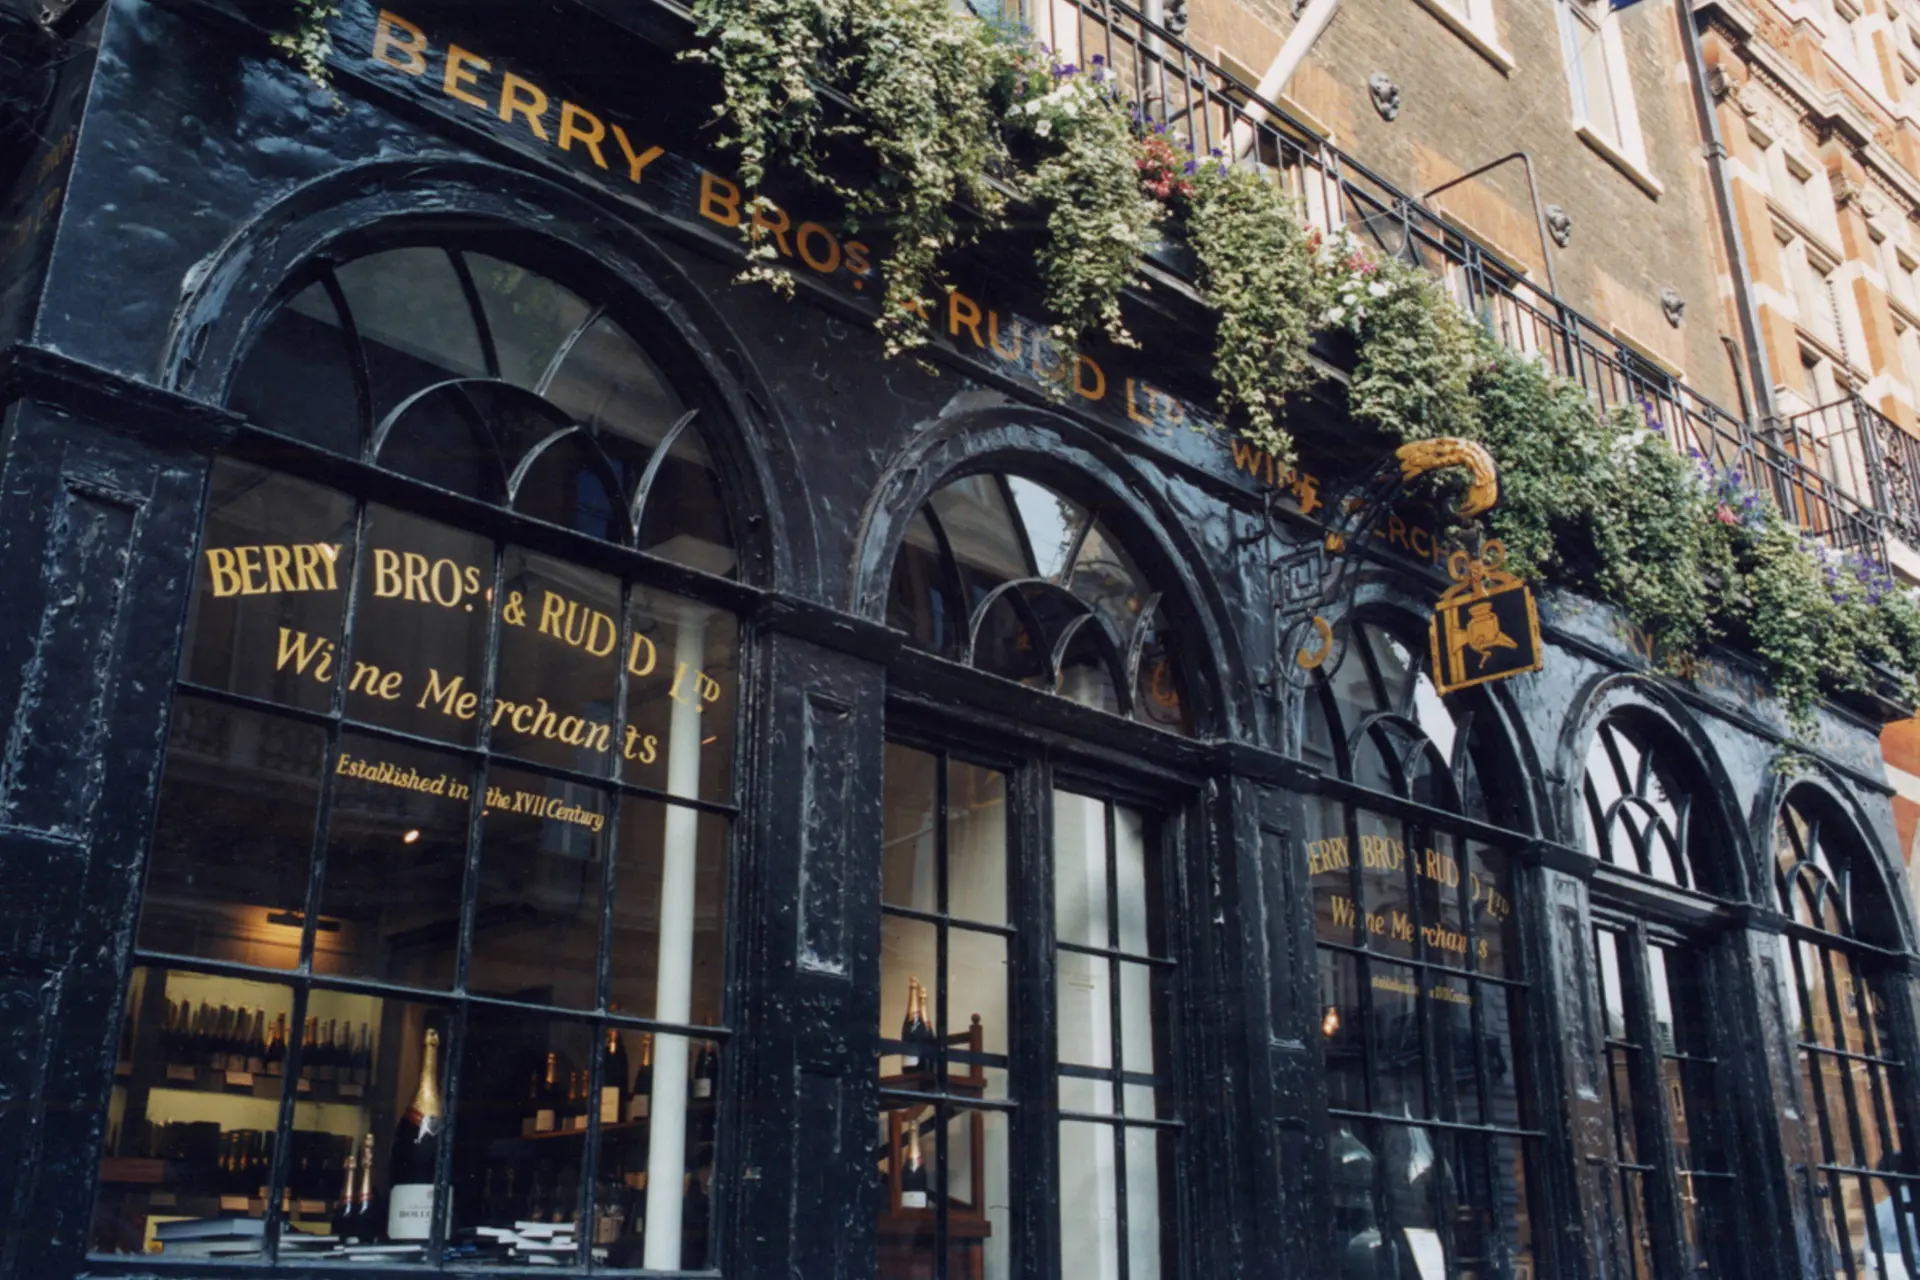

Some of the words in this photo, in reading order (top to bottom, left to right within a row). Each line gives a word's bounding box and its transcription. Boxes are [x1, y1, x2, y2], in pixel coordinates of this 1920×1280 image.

[371, 8, 665, 185] BERRY
[949, 289, 1106, 400] RUDD
[205, 543, 342, 598] BERRY
[502, 589, 527, 628] &
[537, 589, 657, 678] RUDD
[276, 626, 404, 701] Wine
[416, 667, 659, 765] Merchants
[335, 753, 445, 796] Established
[448, 778, 470, 800] in
[486, 786, 512, 811] the
[512, 789, 546, 817] XVII
[546, 798, 605, 832] Century
[1330, 893, 1385, 935] Wine
[1391, 909, 1489, 960] Merchans
